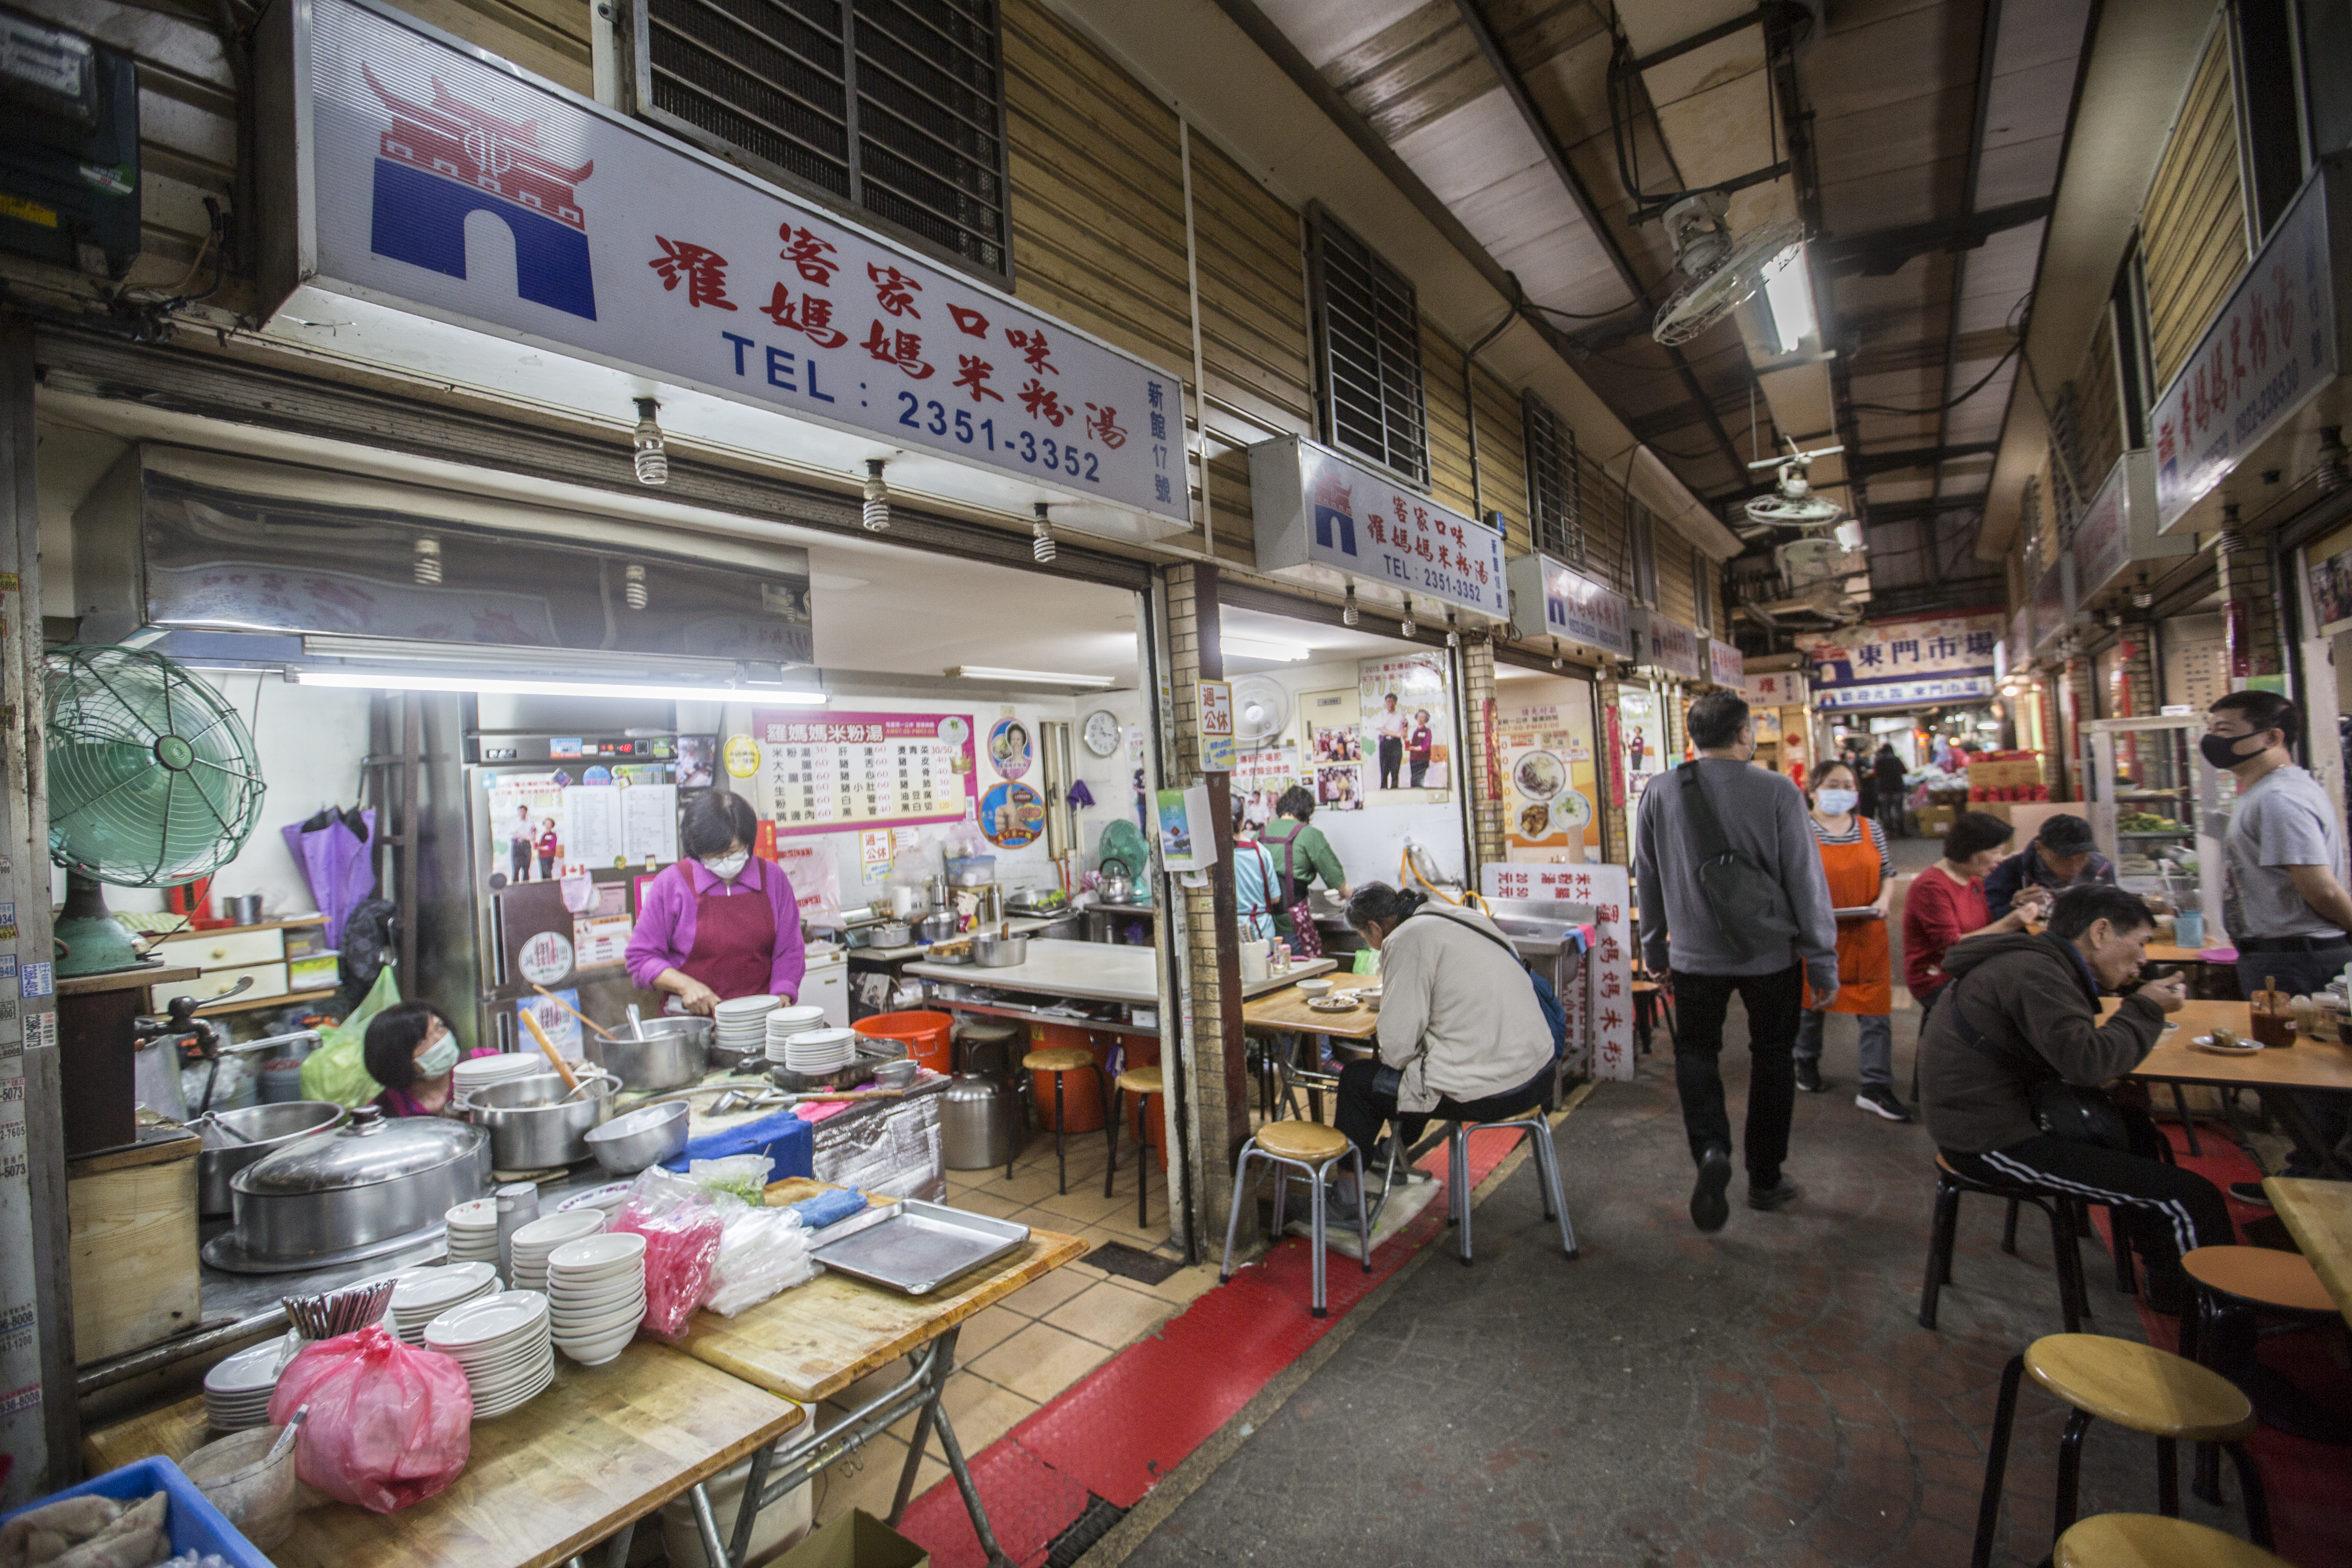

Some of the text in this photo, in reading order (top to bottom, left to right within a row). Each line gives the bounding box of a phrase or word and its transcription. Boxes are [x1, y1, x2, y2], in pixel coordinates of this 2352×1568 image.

[779, 222, 1060, 376] 客家口味
[898, 390, 1100, 483] 2351-3352
[1147, 380, 1171, 504] 新館17號
[1393, 495, 1467, 549] 客家口味
[1424, 568, 1481, 602] 2351-3352
[1858, 631, 1993, 667] 東門市場
[1203, 687, 1227, 707] 週一
[766, 724, 884, 742] 羅媽媽米粉湯
[1205, 709, 1228, 731] 公休
[1236, 752, 1282, 765] 傳統市場節
[865, 833, 886, 846] 週一
[866, 846, 886, 859] 公休
[1541, 873, 1591, 885] 米粉湯
[1596, 903, 1623, 1083] 羅媽媽米粉
[25, 1014, 42, 1048] 2396-5073
